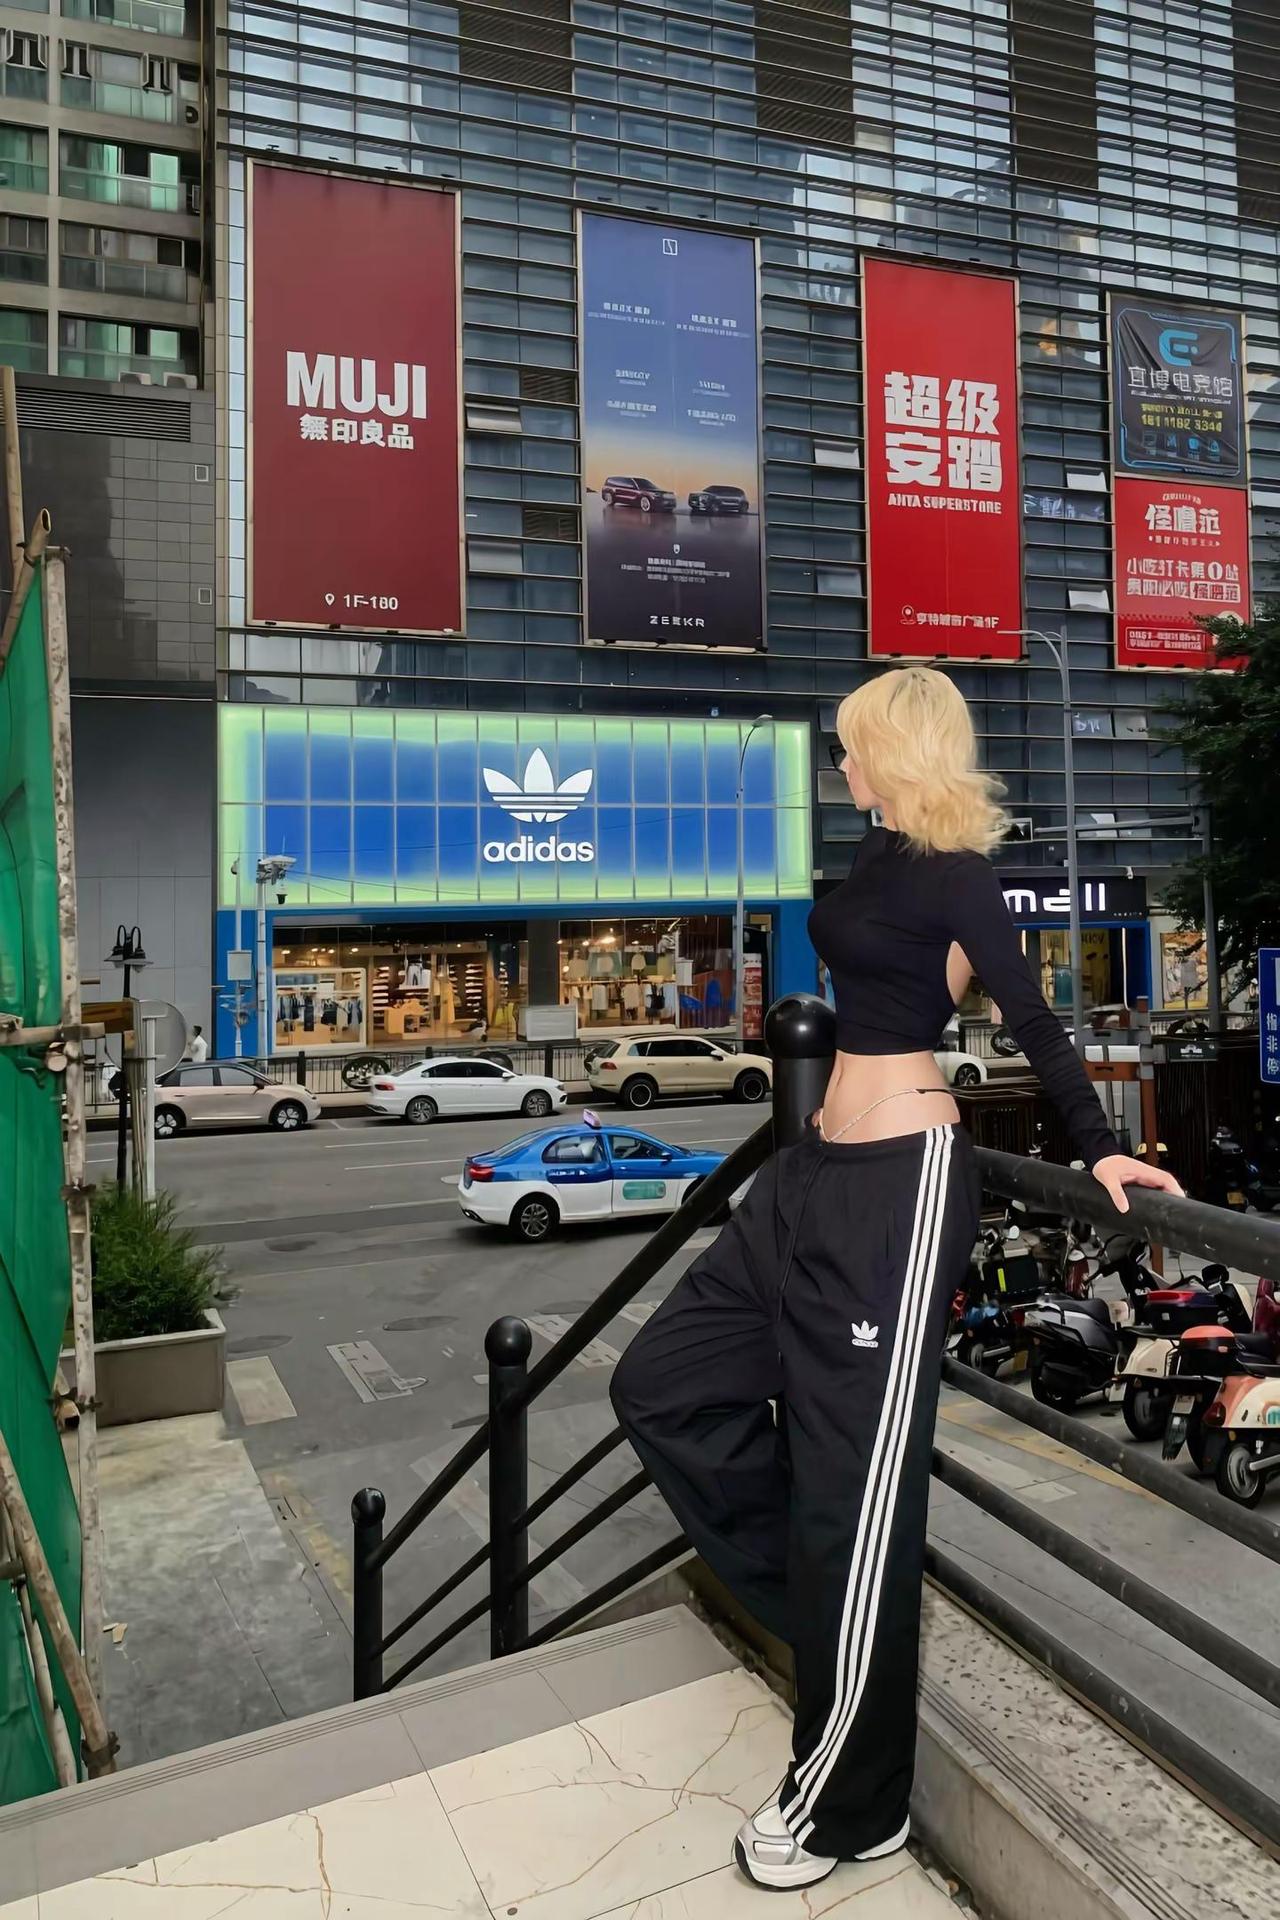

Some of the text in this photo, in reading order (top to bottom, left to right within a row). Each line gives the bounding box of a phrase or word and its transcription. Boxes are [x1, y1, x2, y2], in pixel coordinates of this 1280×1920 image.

[286, 350, 427, 419] MUJI
[883, 371, 1001, 436] 超级
[299, 413, 414, 450] 無印良品
[885, 431, 1002, 492] 安踏
[649, 615, 705, 628] ZEEKR
[483, 835, 594, 862] adidas
